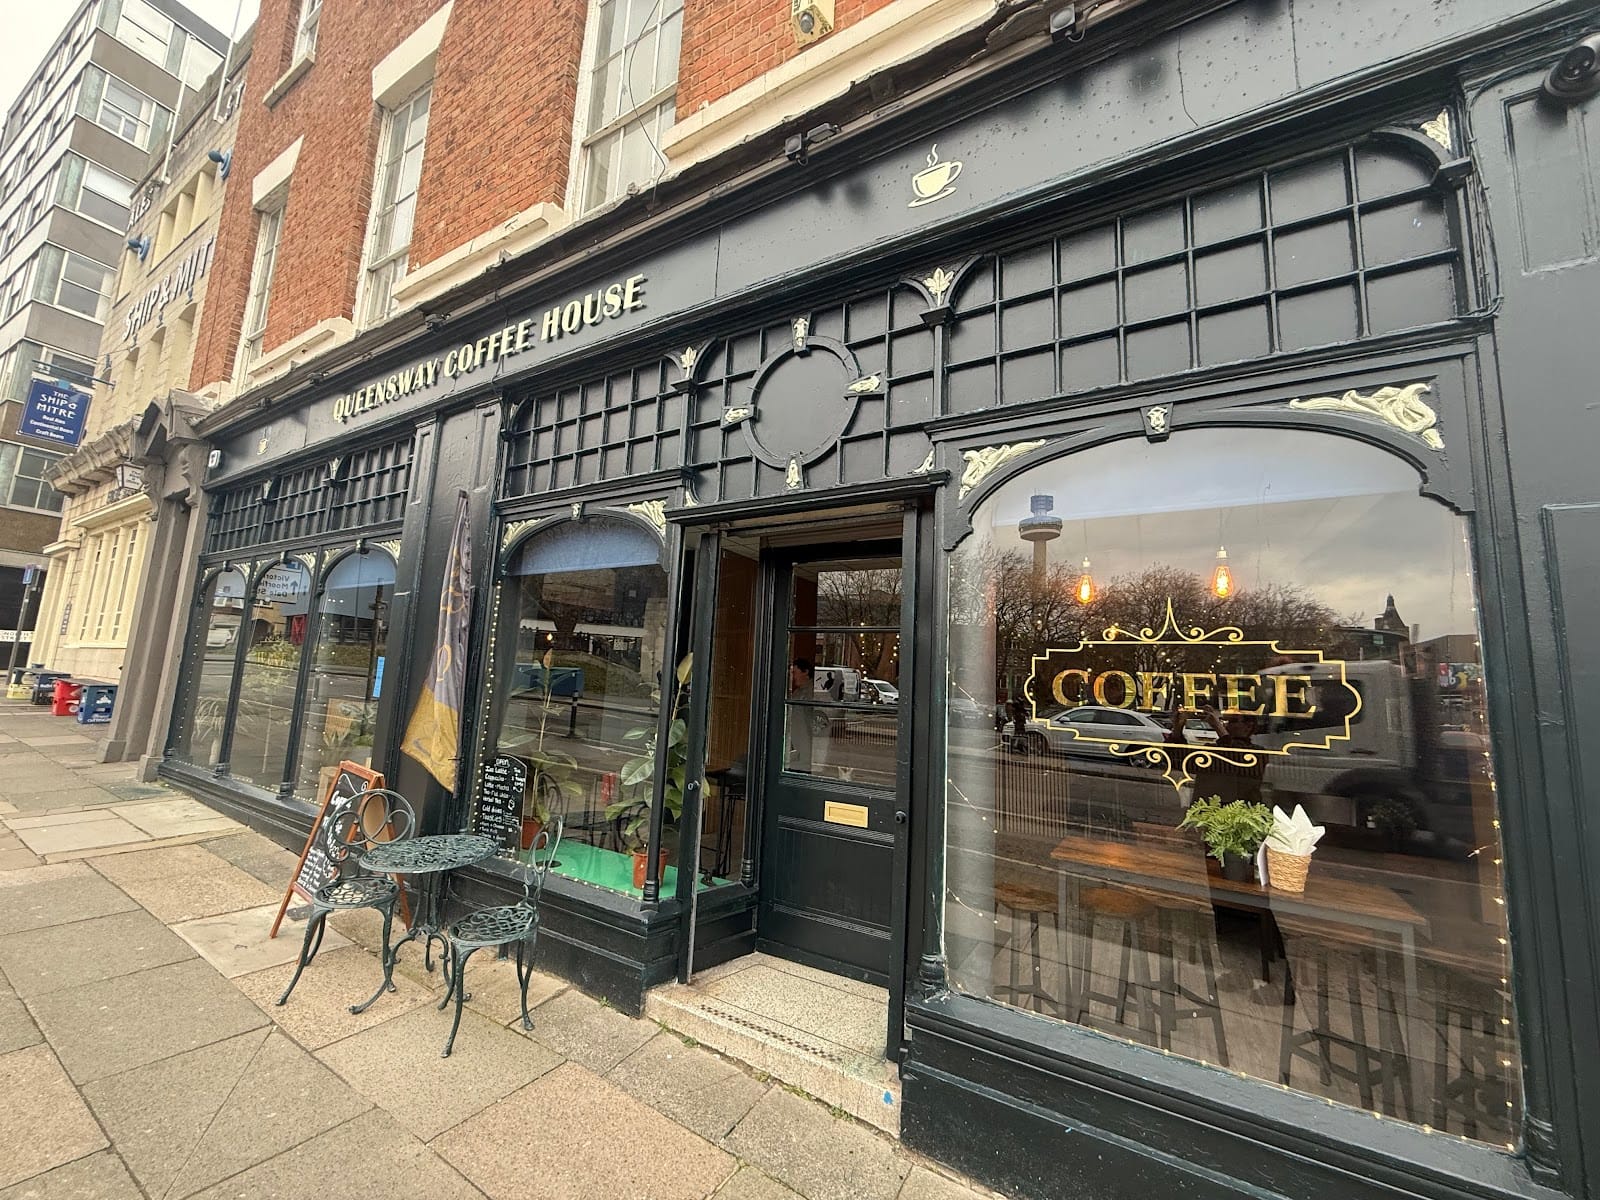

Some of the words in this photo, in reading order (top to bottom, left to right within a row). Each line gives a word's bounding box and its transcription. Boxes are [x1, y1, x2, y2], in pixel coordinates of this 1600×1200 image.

[123, 282, 161, 342] SHIP
[158, 274, 172, 312] &
[333, 358, 438, 423] QUEENSWAY
[443, 319, 531, 377] COFFEE
[540, 273, 645, 341] HOUSE
[36, 402, 77, 419] MITRE
[40, 393, 68, 406] SHIP
[53, 390, 69, 400] THE
[1051, 668, 1317, 718] COFFEE
